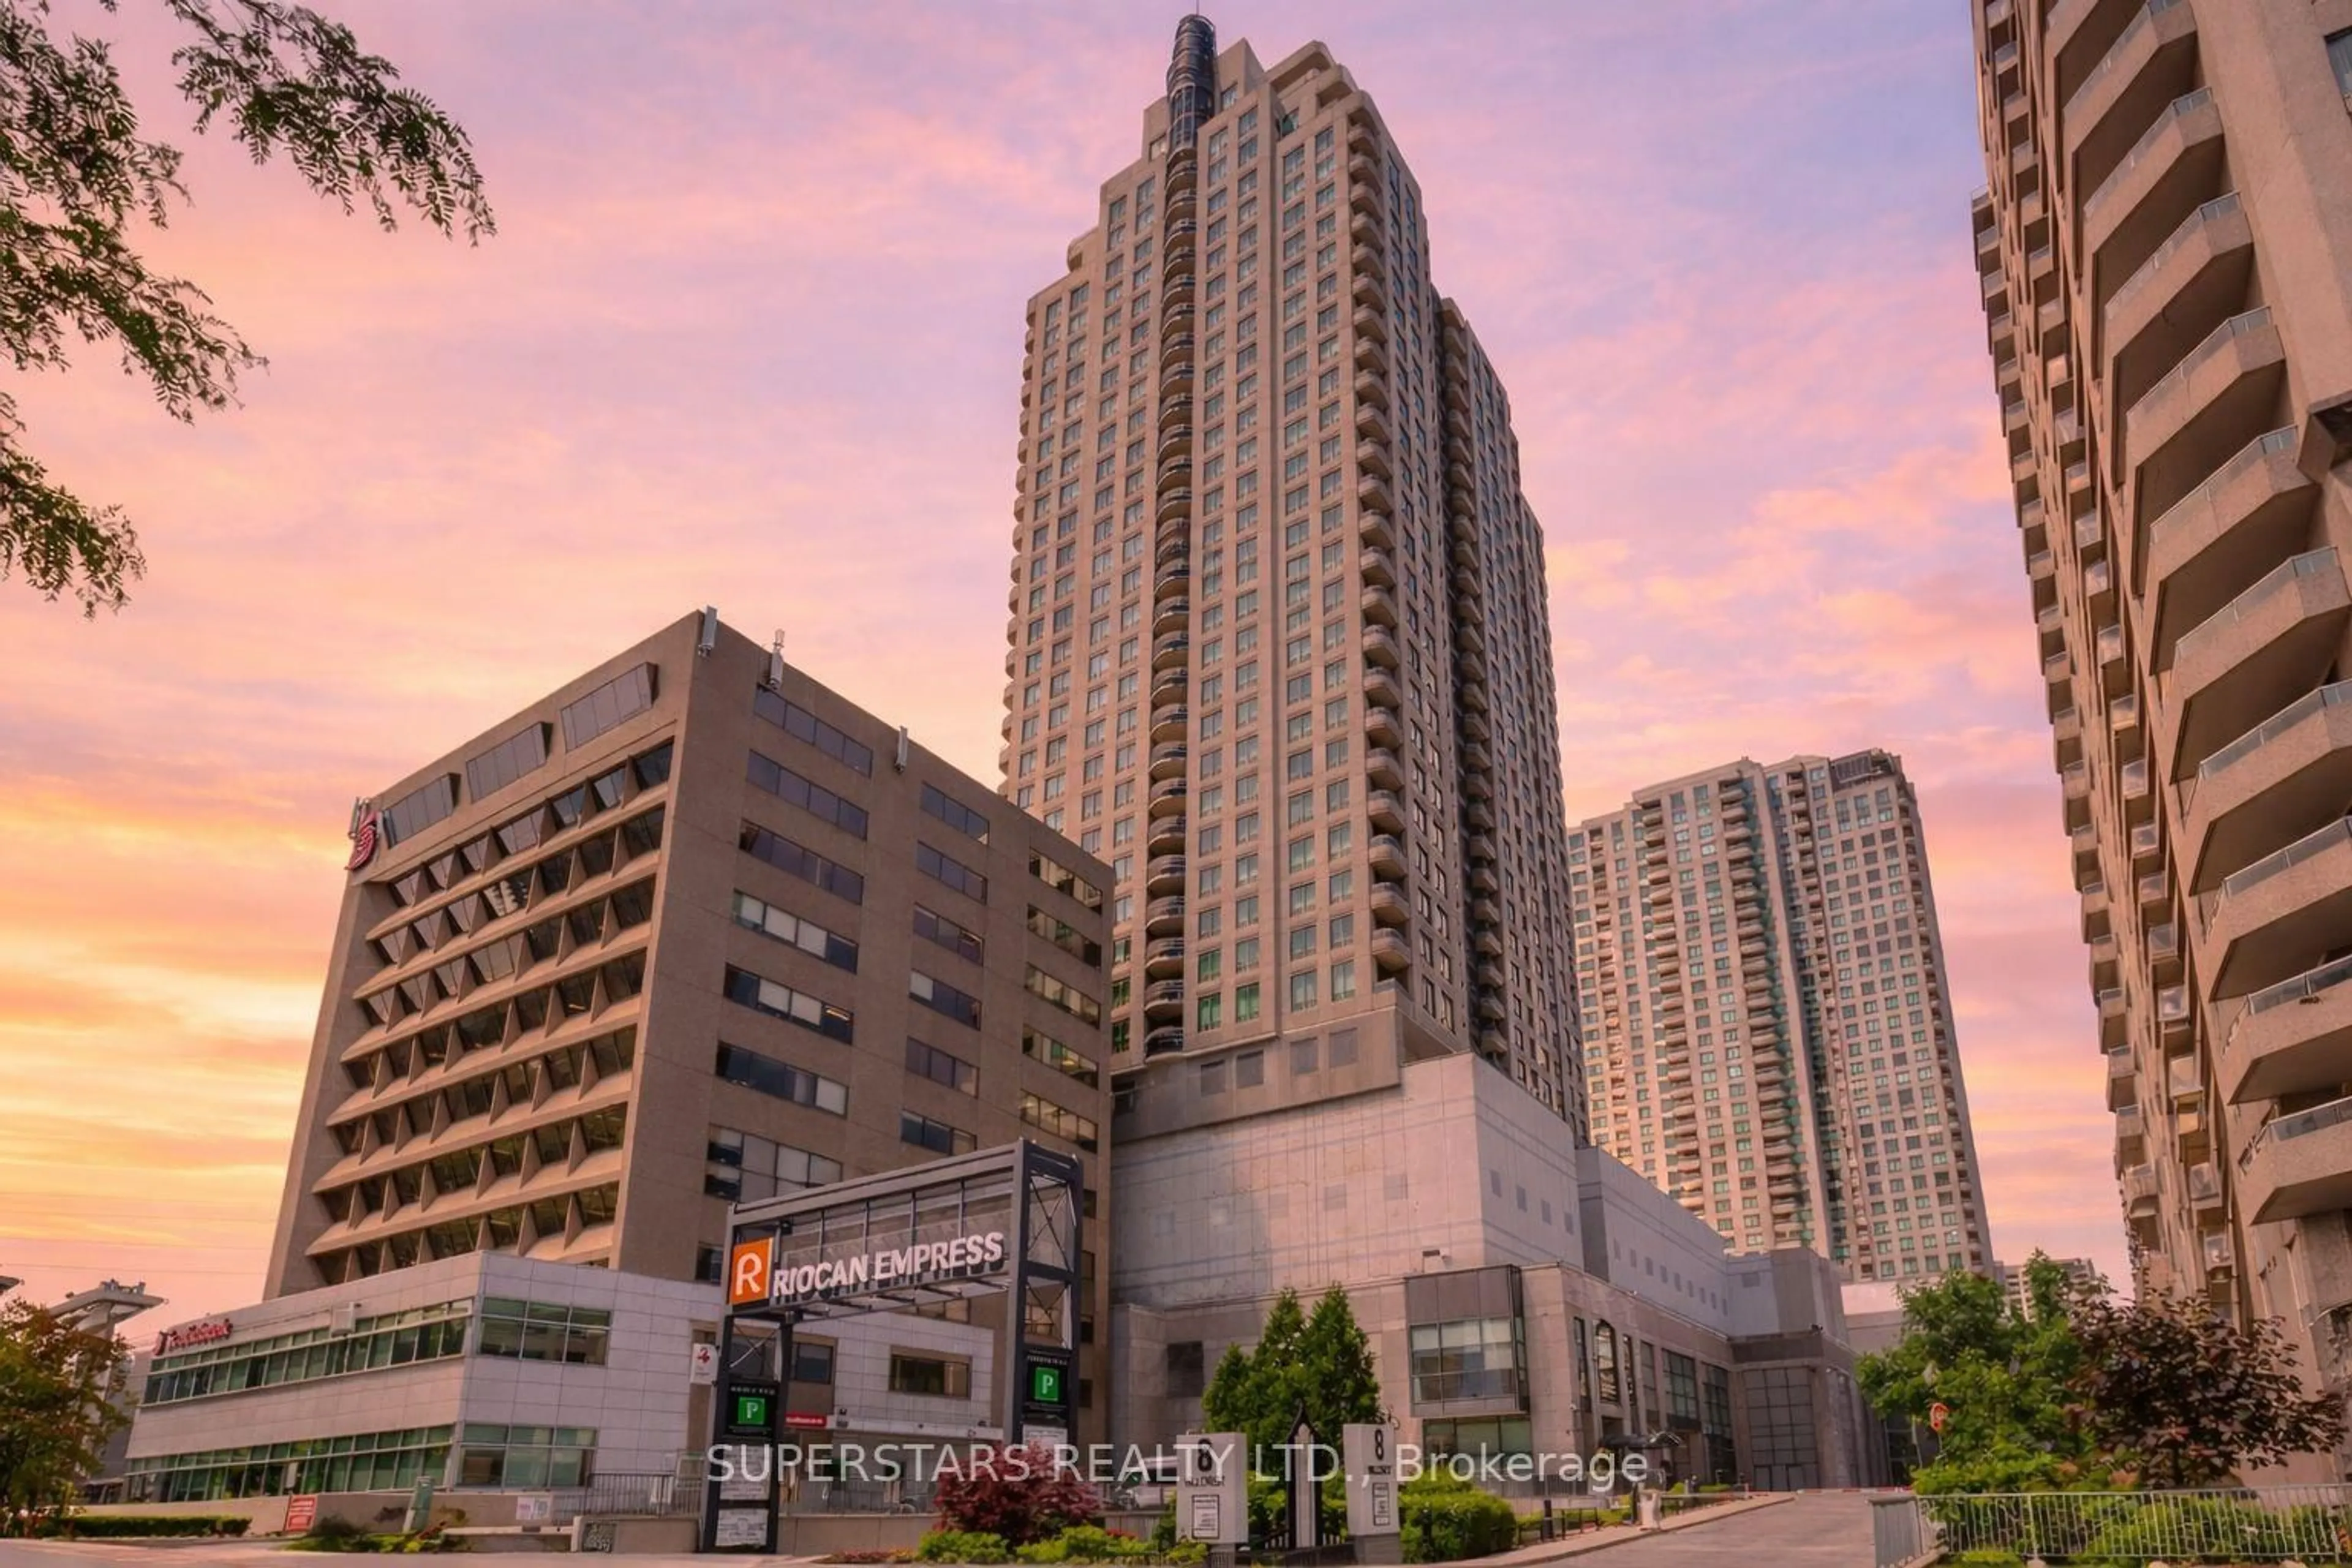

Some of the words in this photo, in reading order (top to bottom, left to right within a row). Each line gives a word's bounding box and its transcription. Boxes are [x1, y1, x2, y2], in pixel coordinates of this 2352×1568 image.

[735, 1252, 761, 1295] R
[773, 1253, 869, 1297] RIOCAN
[872, 1231, 1004, 1281] EMPRESS
[1042, 1374, 1054, 1394] P
[747, 1401, 759, 1419] P
[1374, 1429, 1384, 1460] 8
